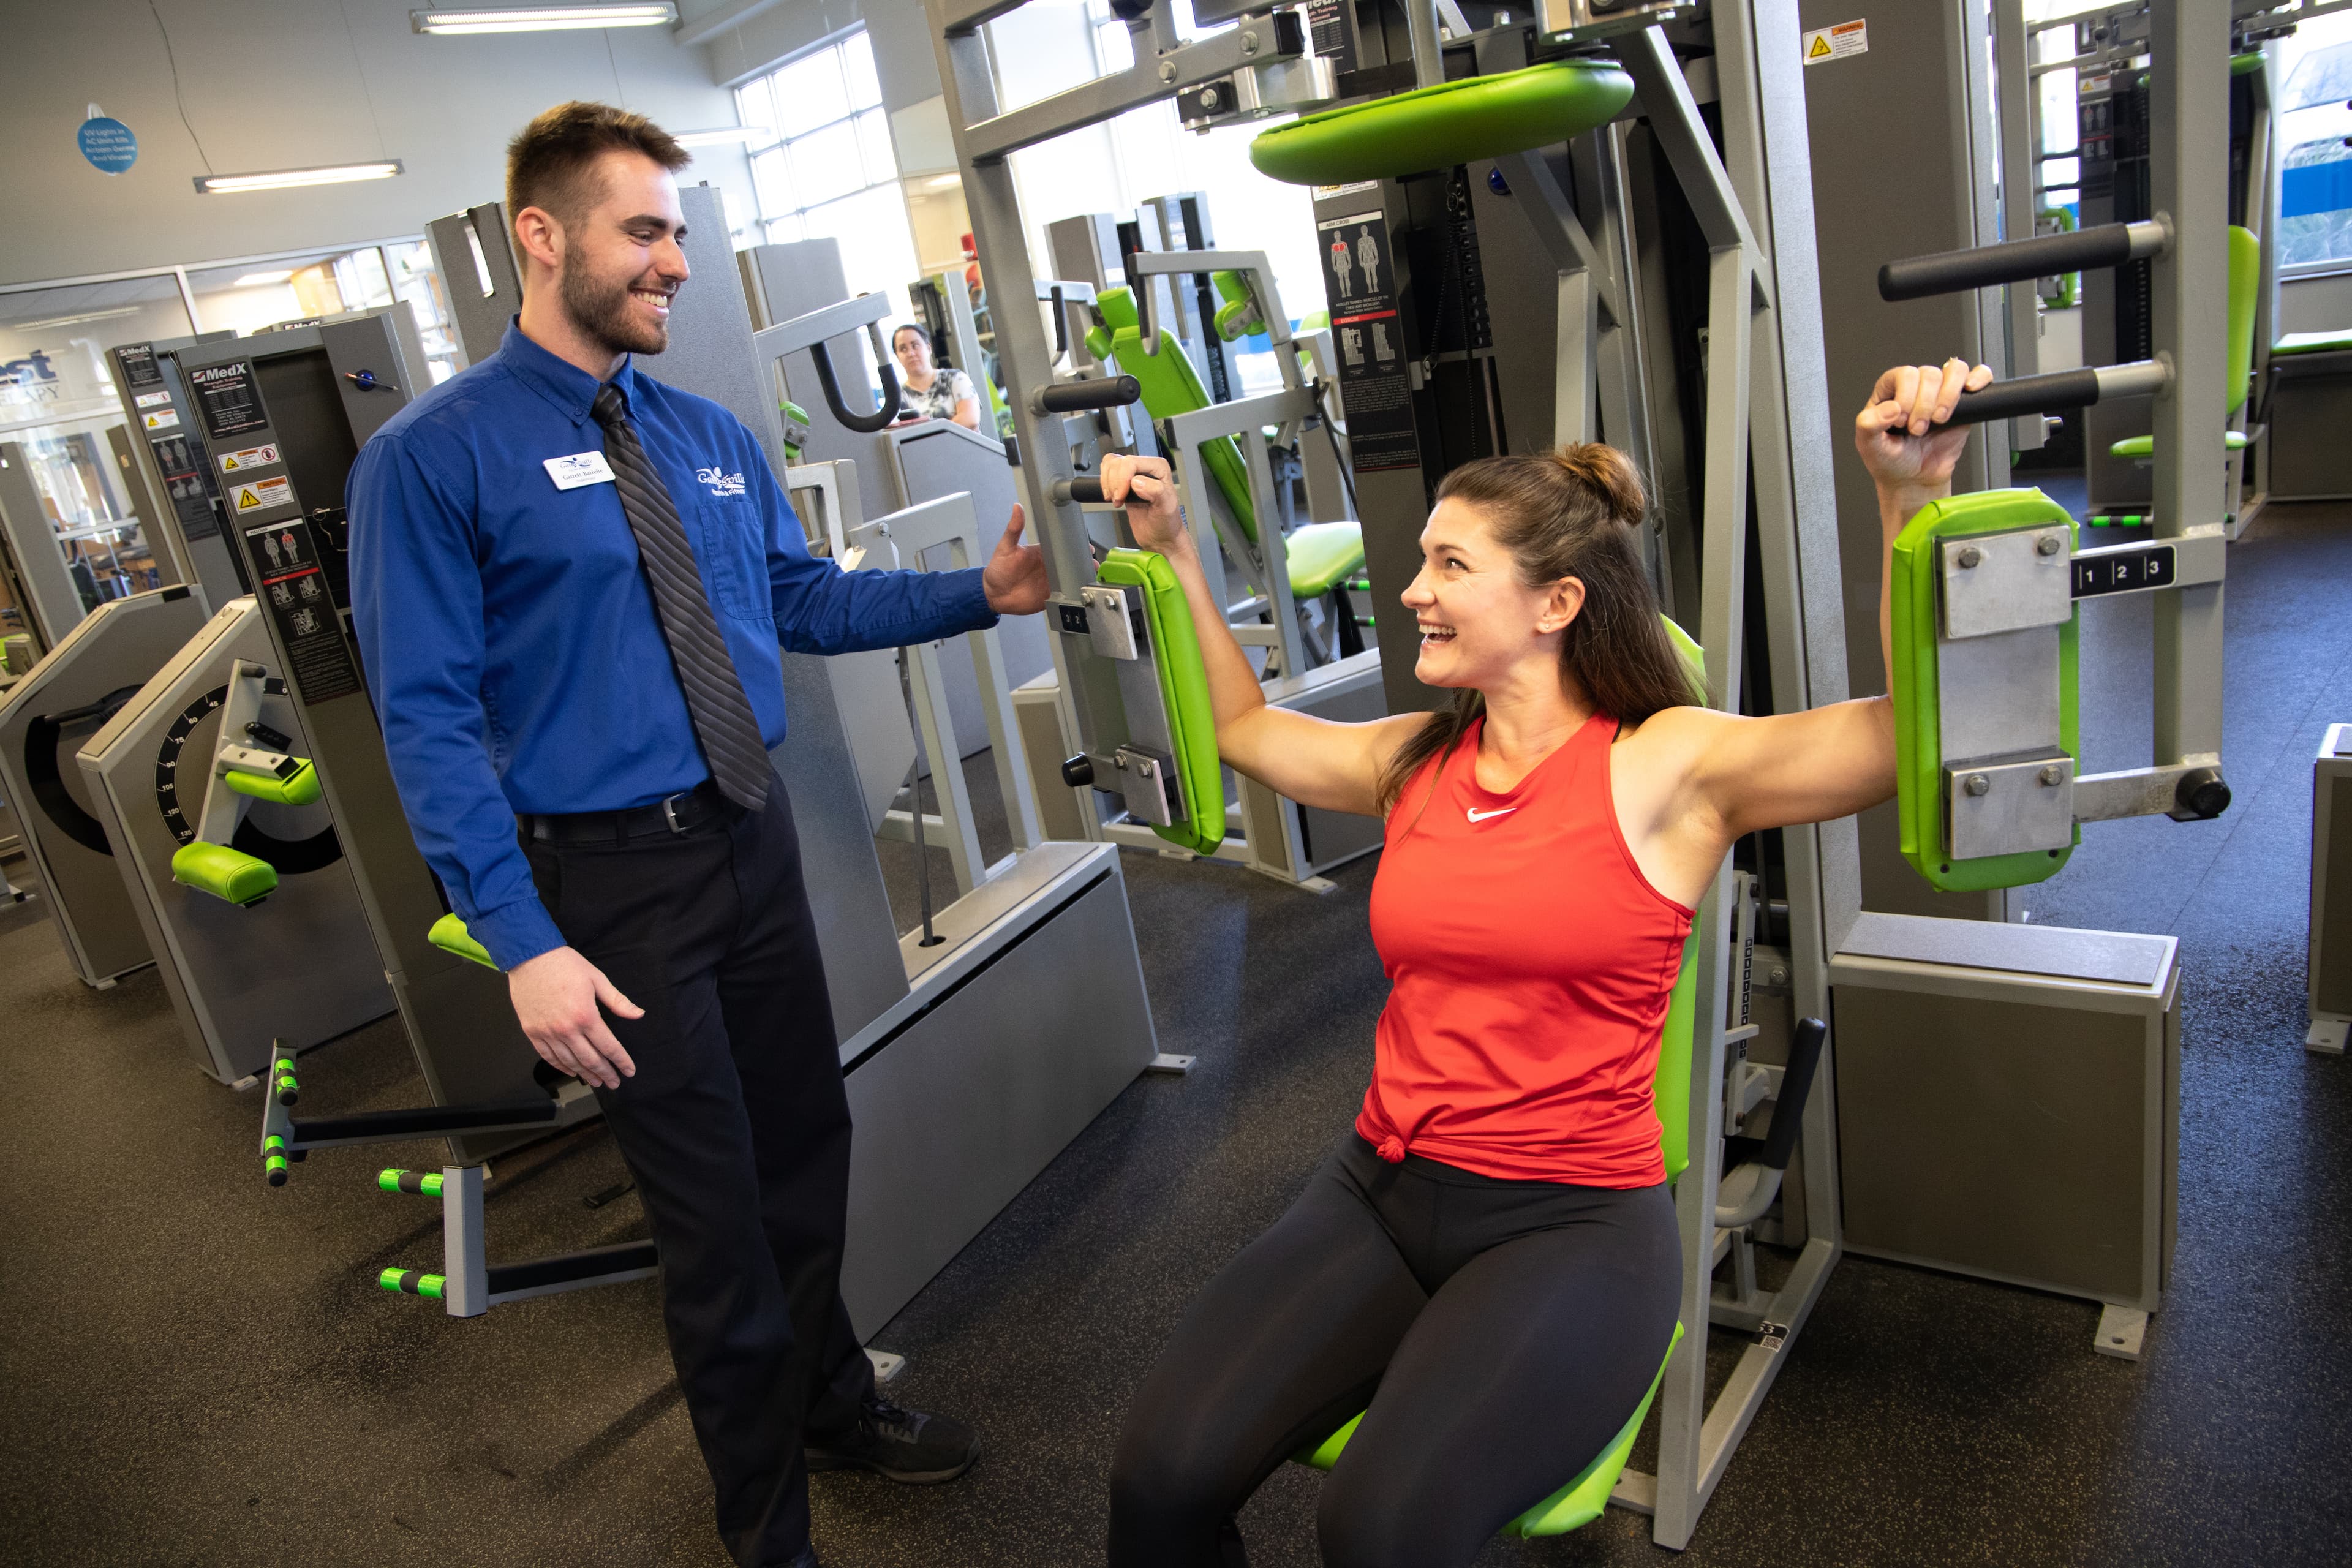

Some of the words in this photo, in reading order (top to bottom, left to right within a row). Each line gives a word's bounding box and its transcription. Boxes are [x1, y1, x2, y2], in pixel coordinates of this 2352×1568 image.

[1838, 23, 1863, 32] WARNING
[1340, 315, 1359, 324] EXERCISE
[127, 345, 151, 355] MedX
[206, 363, 247, 380] MedX
[263, 479, 285, 488] WARNING
[2086, 570, 2093, 582] 1
[2117, 565, 2127, 579] 2
[2149, 560, 2160, 574] 3
[1066, 614, 1070, 623] 3
